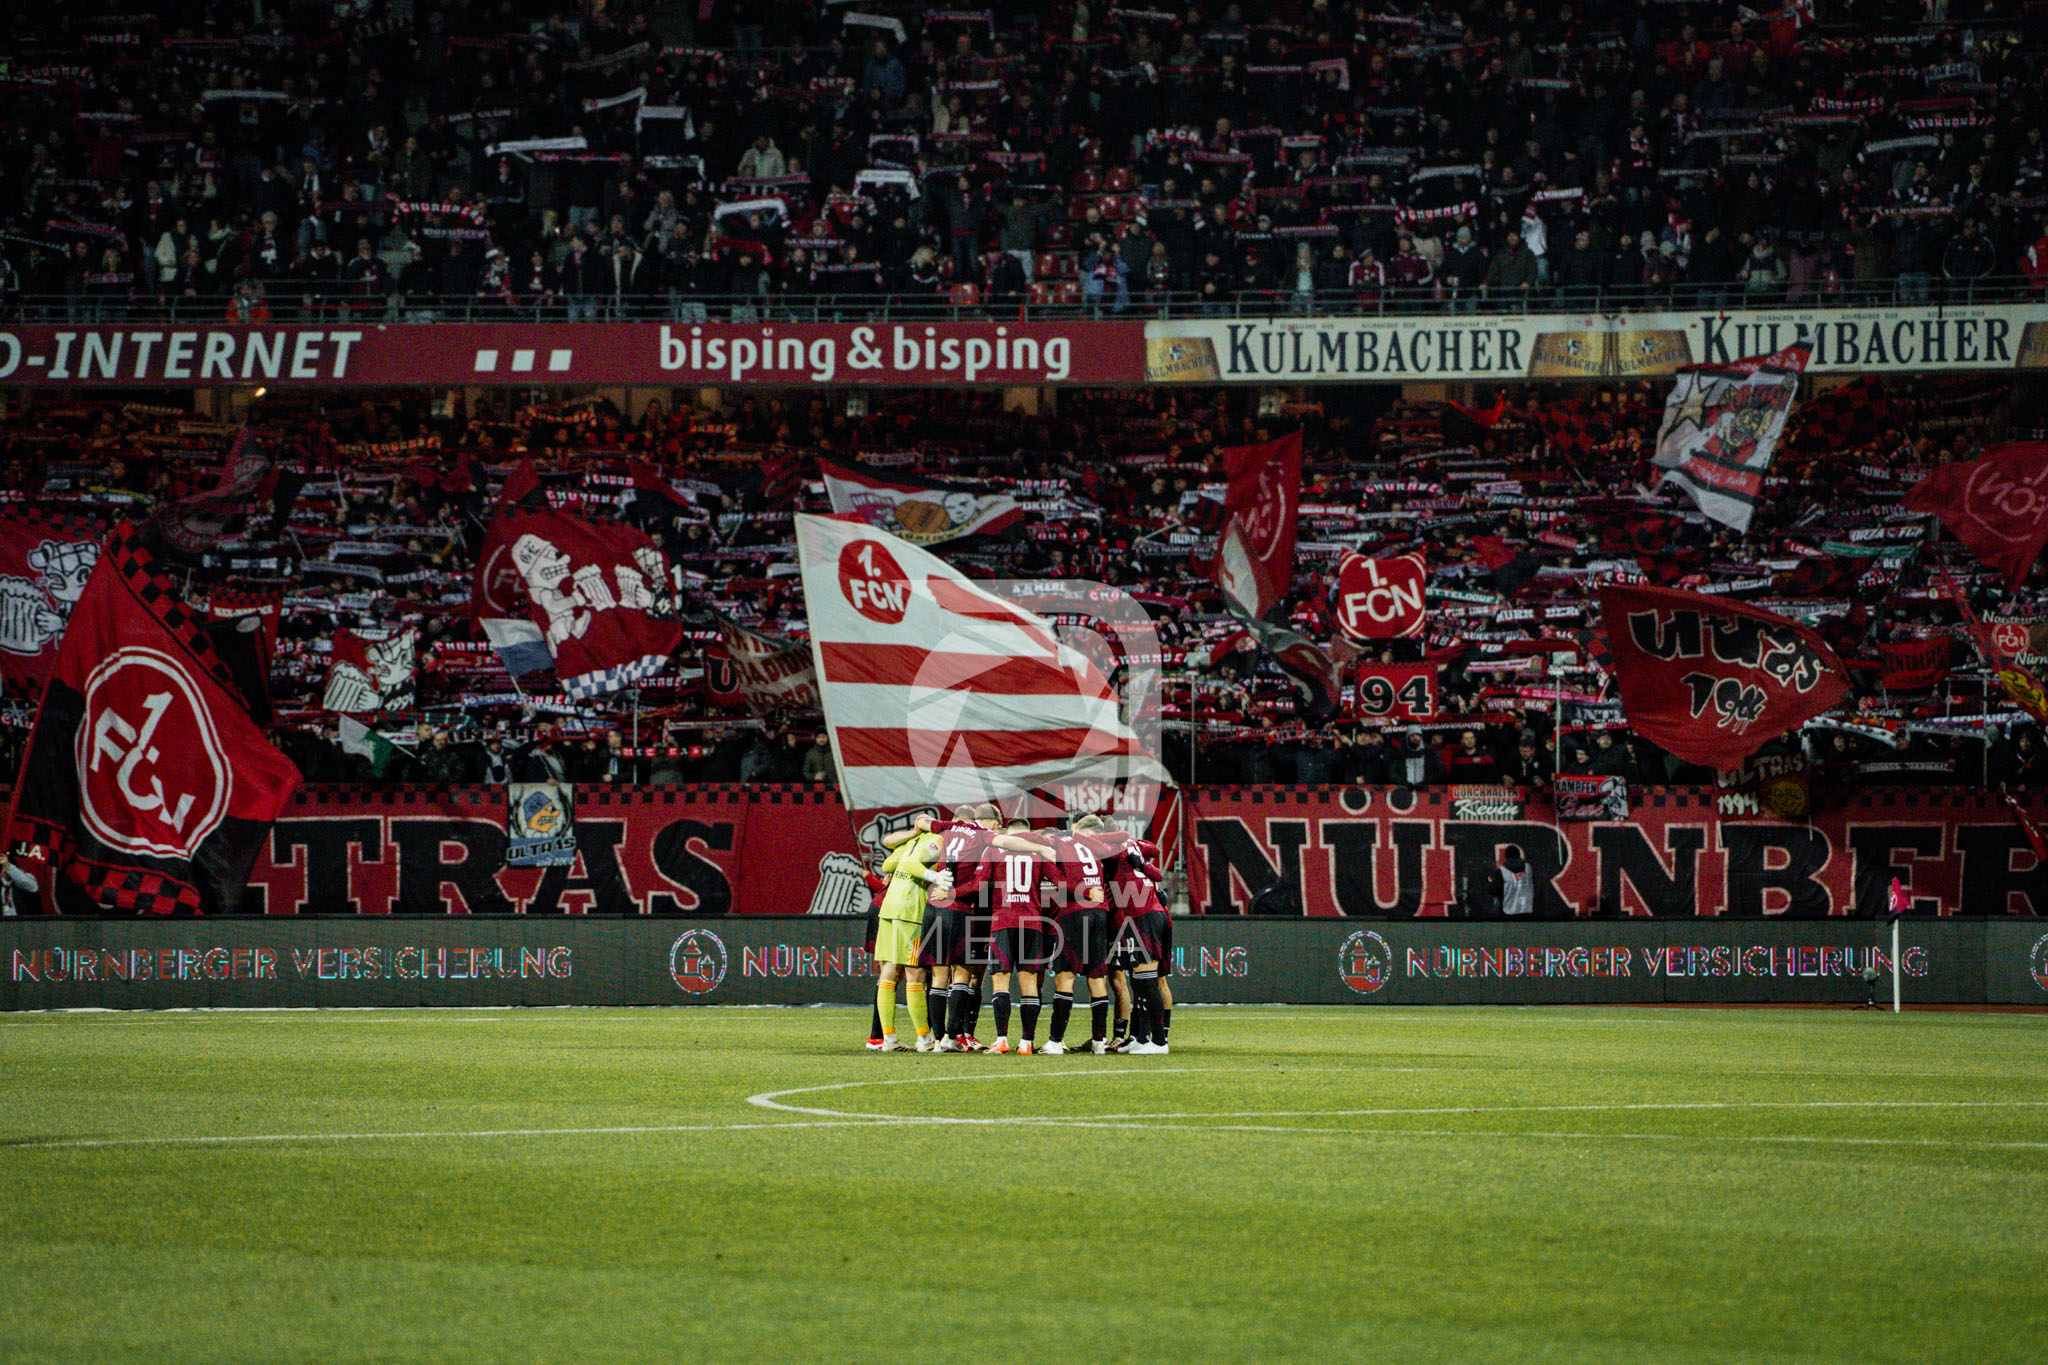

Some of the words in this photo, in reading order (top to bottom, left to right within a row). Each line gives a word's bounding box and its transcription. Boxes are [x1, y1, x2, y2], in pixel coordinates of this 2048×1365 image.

[660, 326, 837, 381] bisping
[847, 327, 883, 370] &
[893, 326, 1072, 381] bisping
[1226, 324, 1525, 375] KULMBACHER
[858, 544, 882, 578] 1.
[1362, 558, 1388, 589] 1.
[849, 579, 905, 614] FCN
[1344, 577, 1424, 629] FCN
[1360, 674, 1433, 717] 94
[1454, 798, 1519, 816] Kevin
[1717, 791, 1759, 816] 1994
[506, 836, 578, 862] ULTRAS
[1073, 842, 1099, 877] 9
[1003, 854, 1034, 894] 10
[11, 945, 278, 982] NÜRNBERGER
[291, 944, 574, 981] VERSICHERUNG
[1406, 945, 1634, 979] NÜRNBERGER
[1641, 945, 1929, 979] VERSICHERUNG
